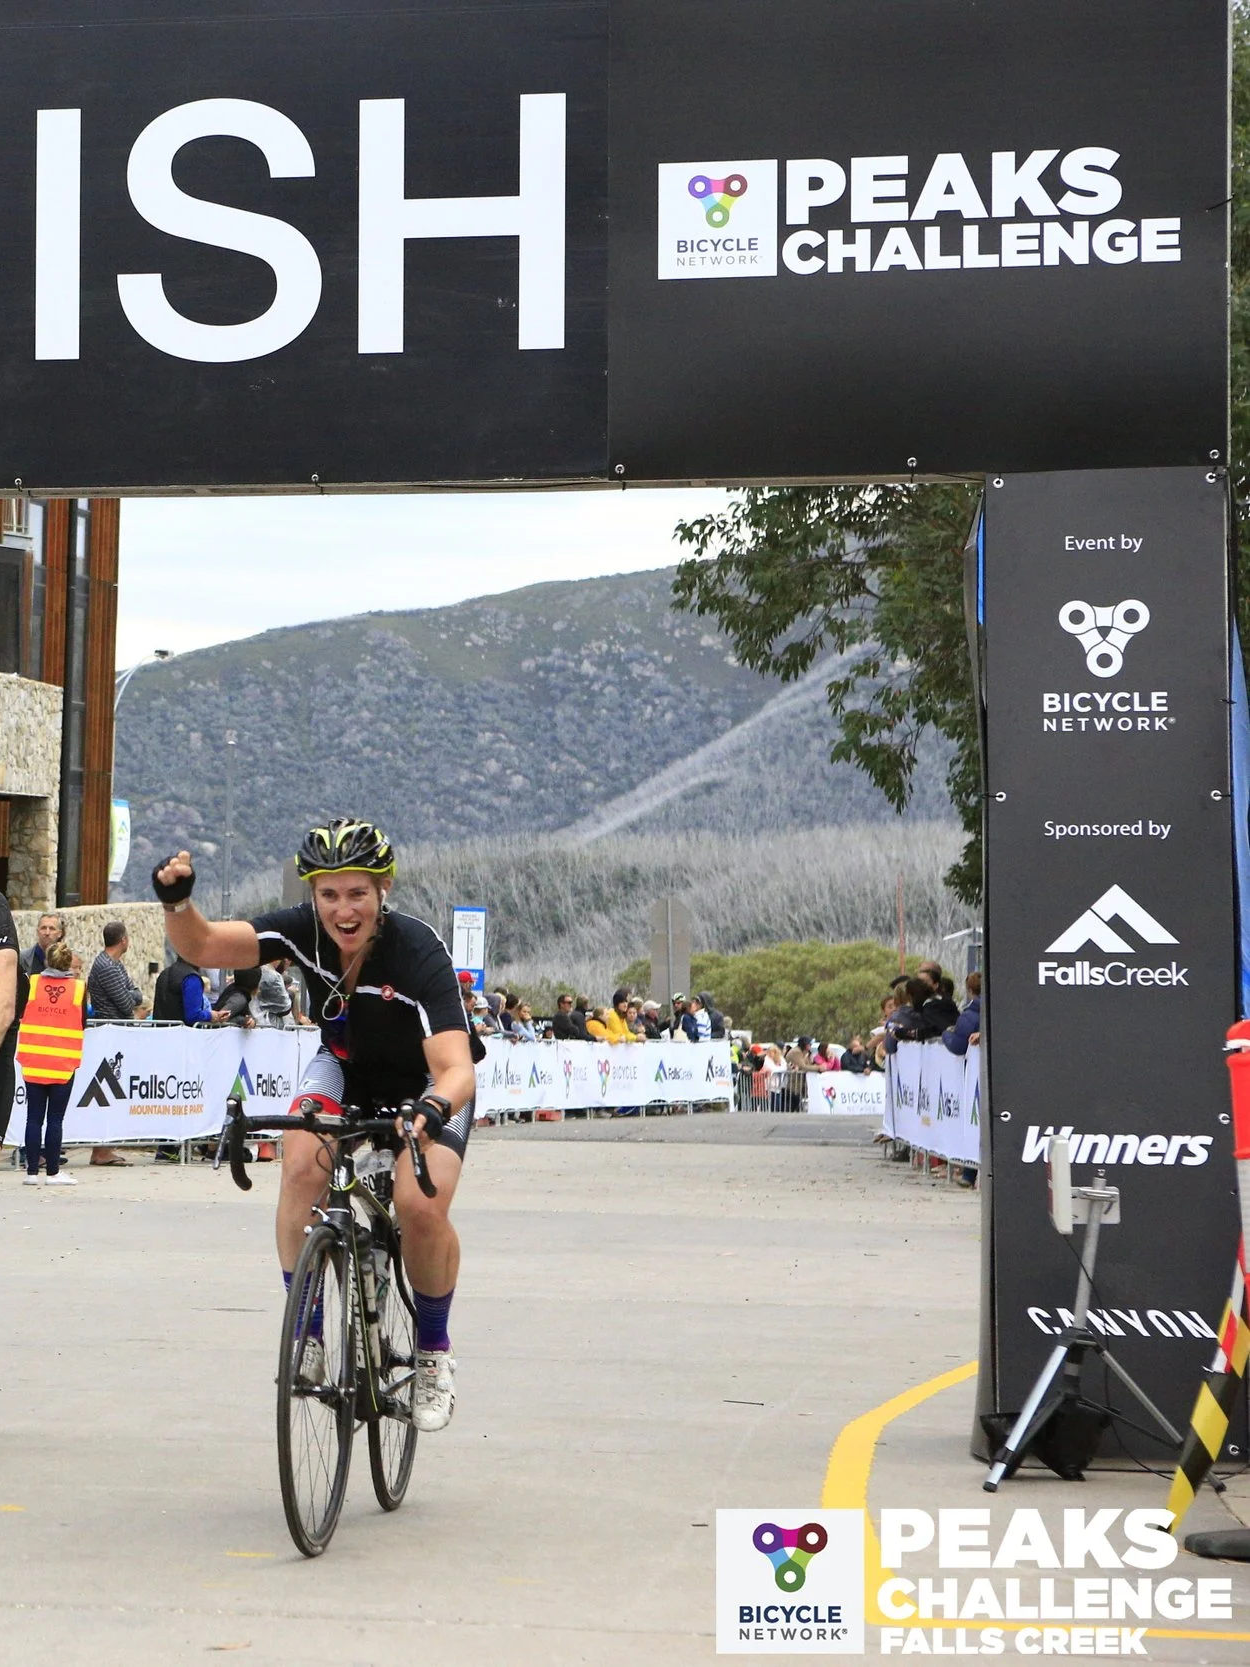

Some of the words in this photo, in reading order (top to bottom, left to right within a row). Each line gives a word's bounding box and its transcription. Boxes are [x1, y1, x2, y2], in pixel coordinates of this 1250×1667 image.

[785, 146, 1122, 225] PEAKS
[676, 237, 759, 254] BICYCLE
[782, 217, 1181, 275] CHALLENGE
[1064, 535, 1115, 551] Event
[1120, 534, 1143, 553] by
[1043, 691, 1168, 713] BICYCLE
[1044, 820, 1143, 839] Sponsored
[1149, 820, 1171, 839] by
[1038, 961, 1189, 986] FallsCreek
[38, 1006, 67, 1015] BICYCLE
[612, 1066, 637, 1080] BICYCLE
[129, 1074, 204, 1100] FallsCreek
[256, 1073, 291, 1098] FallsCreek
[841, 1092, 882, 1104] BICYCLE
[129, 1105, 170, 1116] MOUNTAIN
[171, 1105, 188, 1116] BIKE
[189, 1104, 204, 1115] PARK
[1021, 1125, 1214, 1166] Winners
